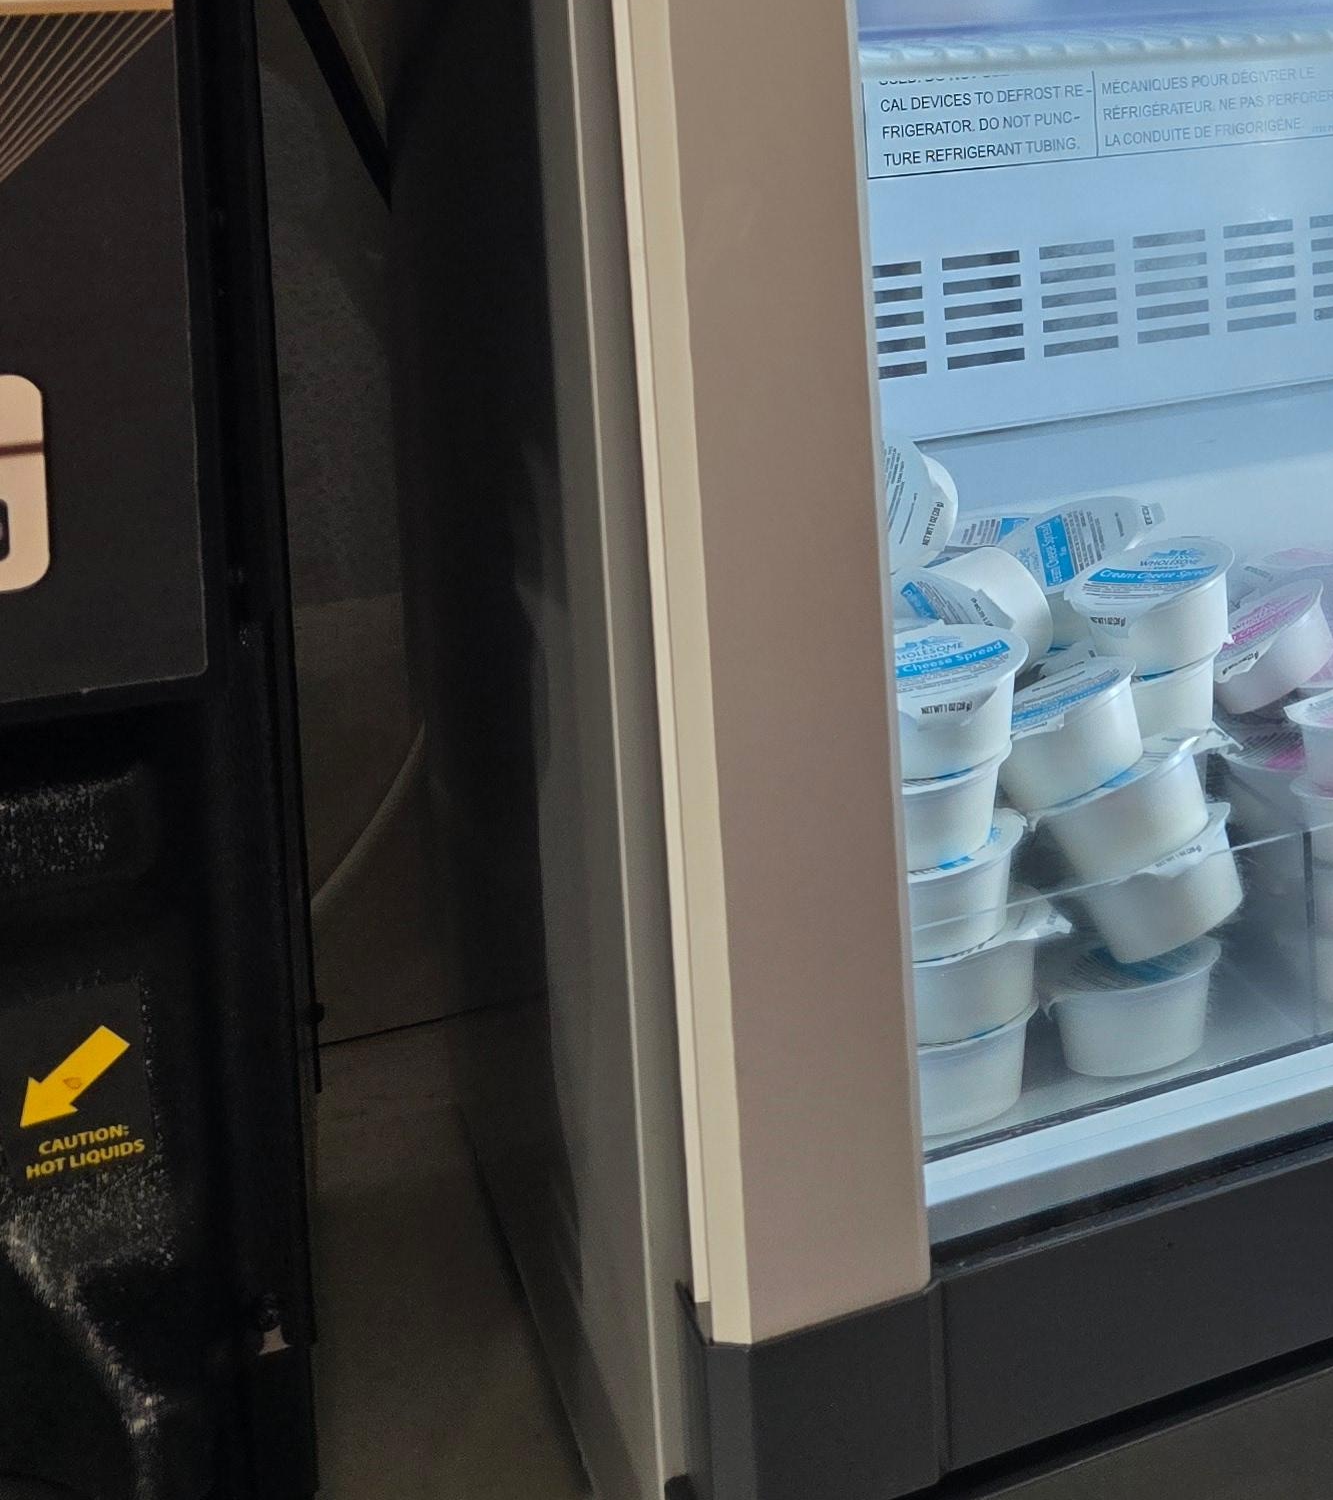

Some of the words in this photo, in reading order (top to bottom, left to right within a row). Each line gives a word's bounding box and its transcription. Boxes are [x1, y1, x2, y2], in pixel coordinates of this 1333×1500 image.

[1101, 75, 1188, 95] MÉCANIQUES
[1192, 73, 1228, 88] POUR
[1232, 66, 1296, 85] DÉGIVRER
[1299, 66, 1315, 80] LE
[880, 99, 907, 113] CAL
[911, 93, 972, 110] DEVICES
[974, 91, 993, 105] TO
[997, 86, 1060, 104] DEFROST
[1103, 100, 1216, 121] RÉFRIGÉRATEUR.
[1219, 98, 1237, 111] NE
[1240, 95, 1265, 109] PAS
[882, 119, 975, 140] FRIGERATOR.
[979, 117, 999, 131] DO
[1002, 114, 1031, 129] NOT
[1104, 133, 1121, 148] LA
[1124, 126, 1191, 145] CONDUITE
[1194, 124, 1212, 138] DE
[884, 151, 921, 167] TURE
[925, 142, 1023, 164] REFRIGERANT
[1025, 137, 1080, 153] TUBING.
[1100, 569, 1136, 579] Cream
[1137, 571, 1177, 579] Cheese
[902, 657, 953, 673] Cheese
[956, 641, 1003, 661] Spread
[38, 1124, 130, 1156] CAUTION:
[26, 1157, 65, 1180] HOT
[70, 1139, 146, 1169] LIQUIDS
